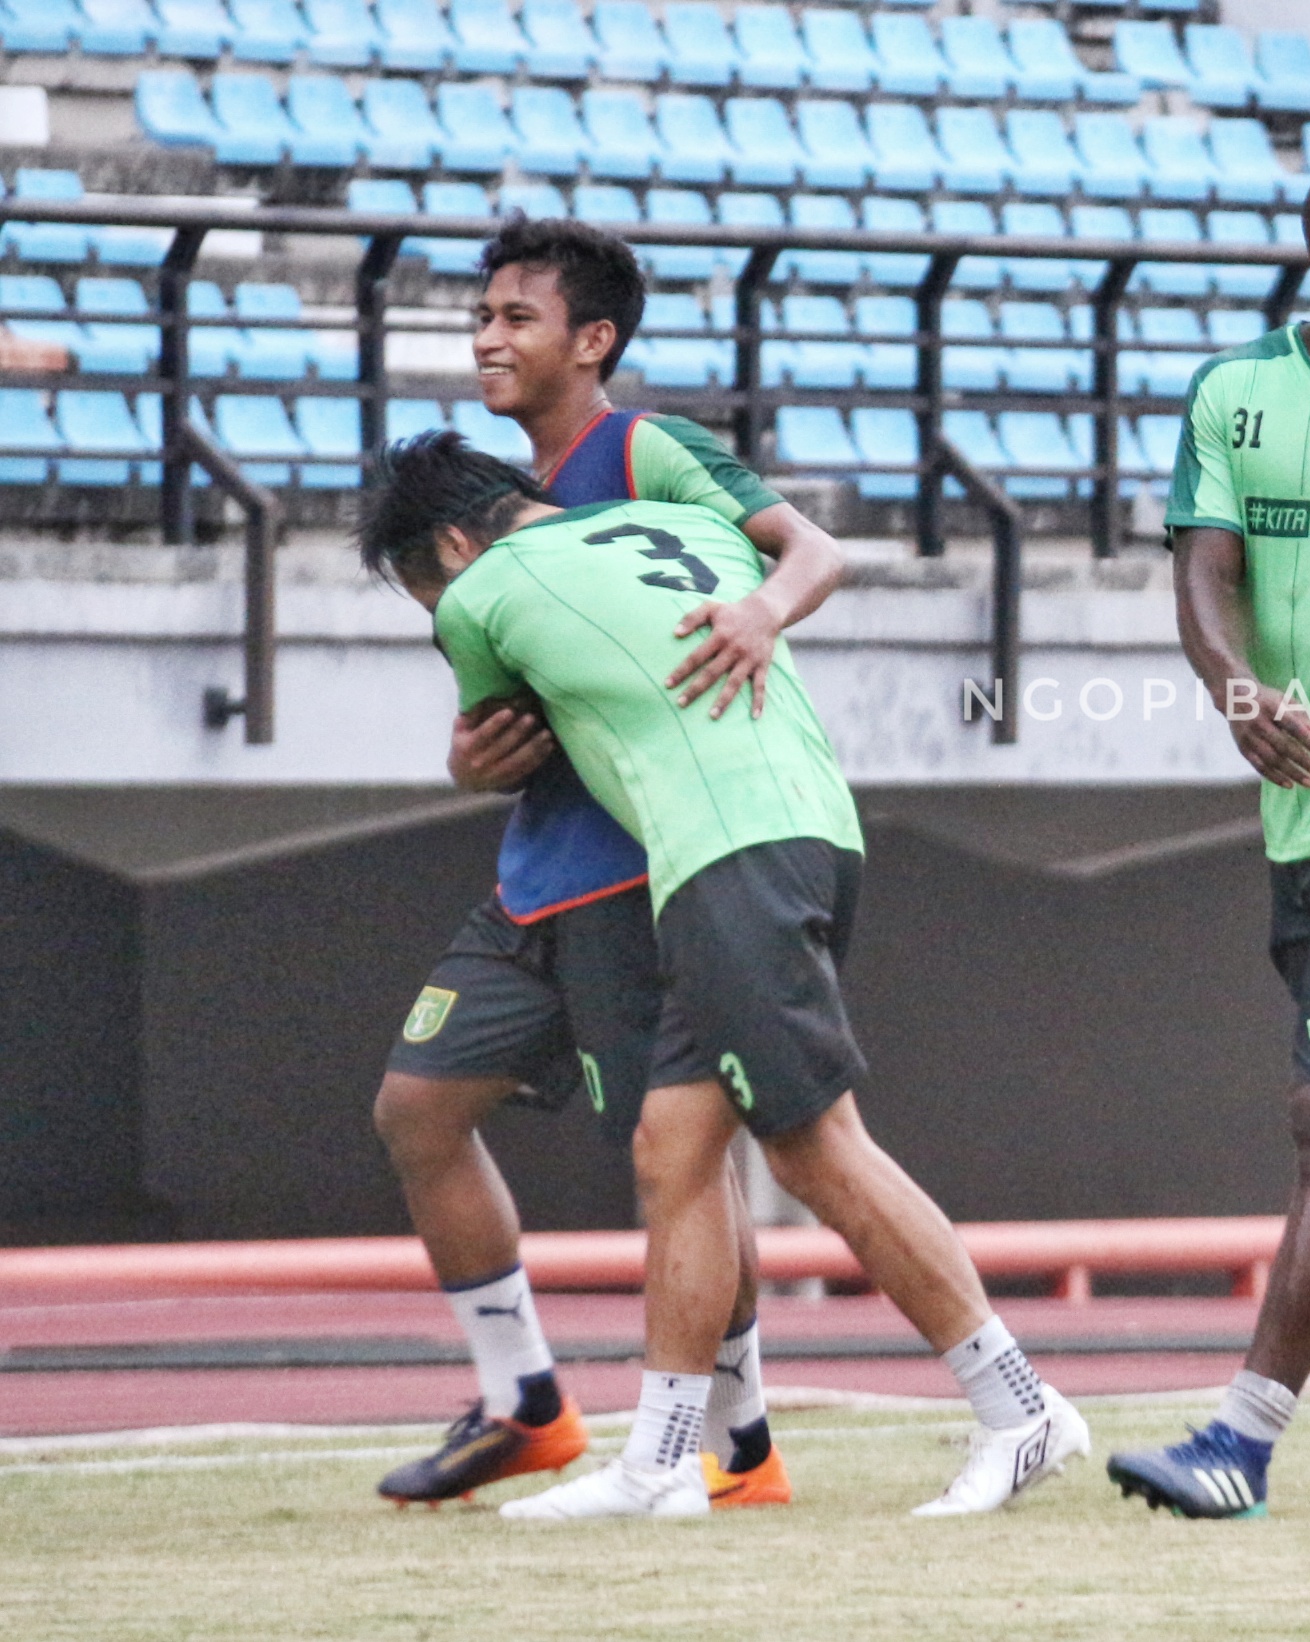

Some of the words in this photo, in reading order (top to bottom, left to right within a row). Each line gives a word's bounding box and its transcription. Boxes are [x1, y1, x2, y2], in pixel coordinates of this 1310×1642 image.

[1232, 407, 1263, 449] 31
[1248, 502, 1308, 531] #KITA
[581, 522, 720, 595] 3
[719, 1052, 754, 1110] 3
